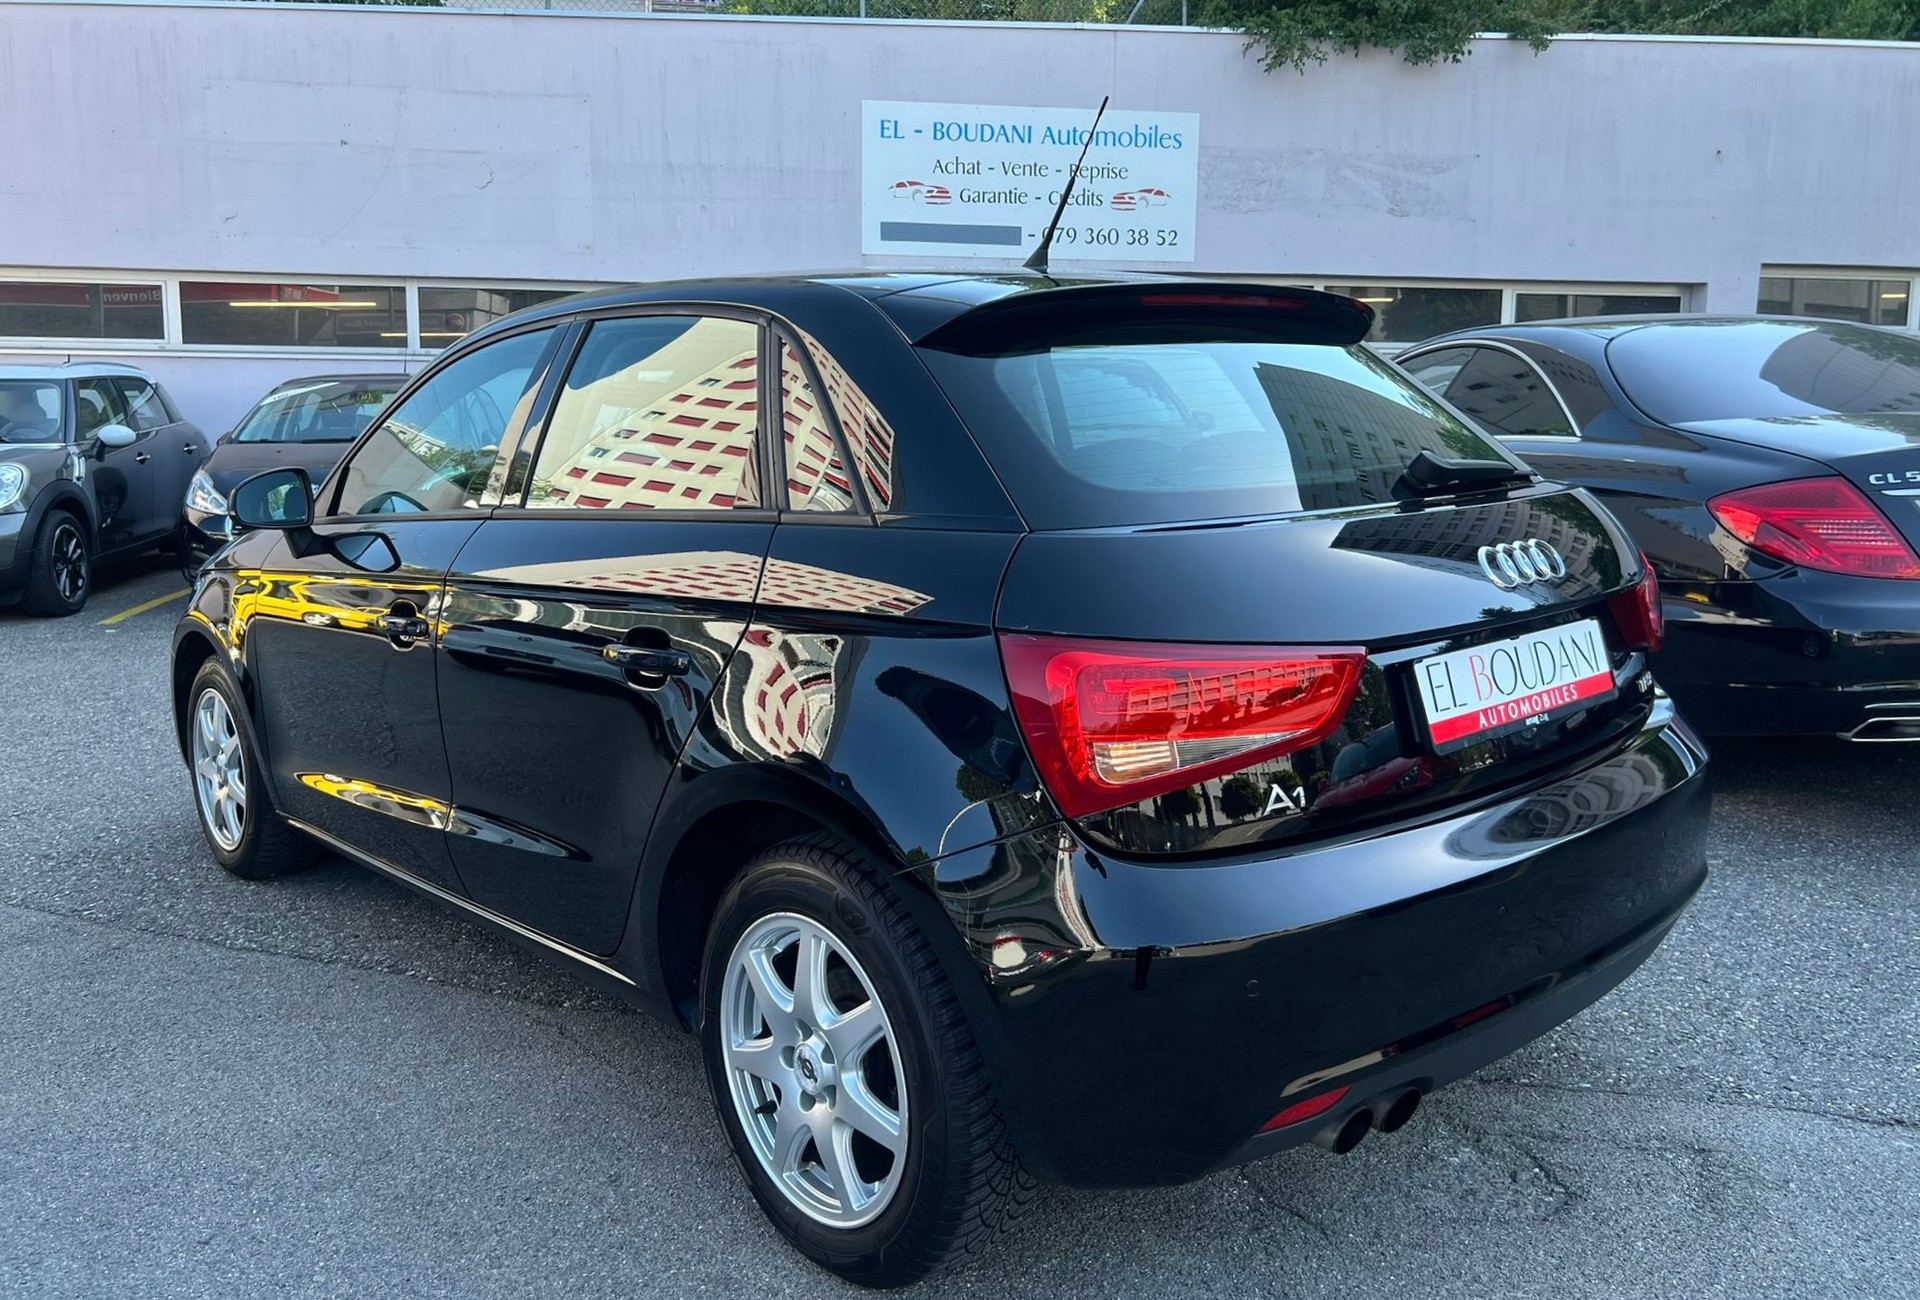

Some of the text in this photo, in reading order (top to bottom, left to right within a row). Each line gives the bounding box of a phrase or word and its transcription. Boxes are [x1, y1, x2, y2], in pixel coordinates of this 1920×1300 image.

[880, 119, 905, 139] EL
[933, 121, 1032, 144] BOUDANI
[1041, 124, 1182, 149] Automobiles
[932, 156, 982, 175] Achat
[1001, 160, 1049, 177] Vente
[1069, 162, 1128, 184] Reprise
[959, 187, 1028, 205] Garantie
[1084, 228, 1119, 246] 360
[1126, 229, 1149, 246] 38
[1156, 230, 1178, 246] 52
[1426, 631, 1600, 713] EL BOUDANI
[1479, 684, 1578, 728] AUTOMOBILES
[1263, 783, 1306, 816] A1
